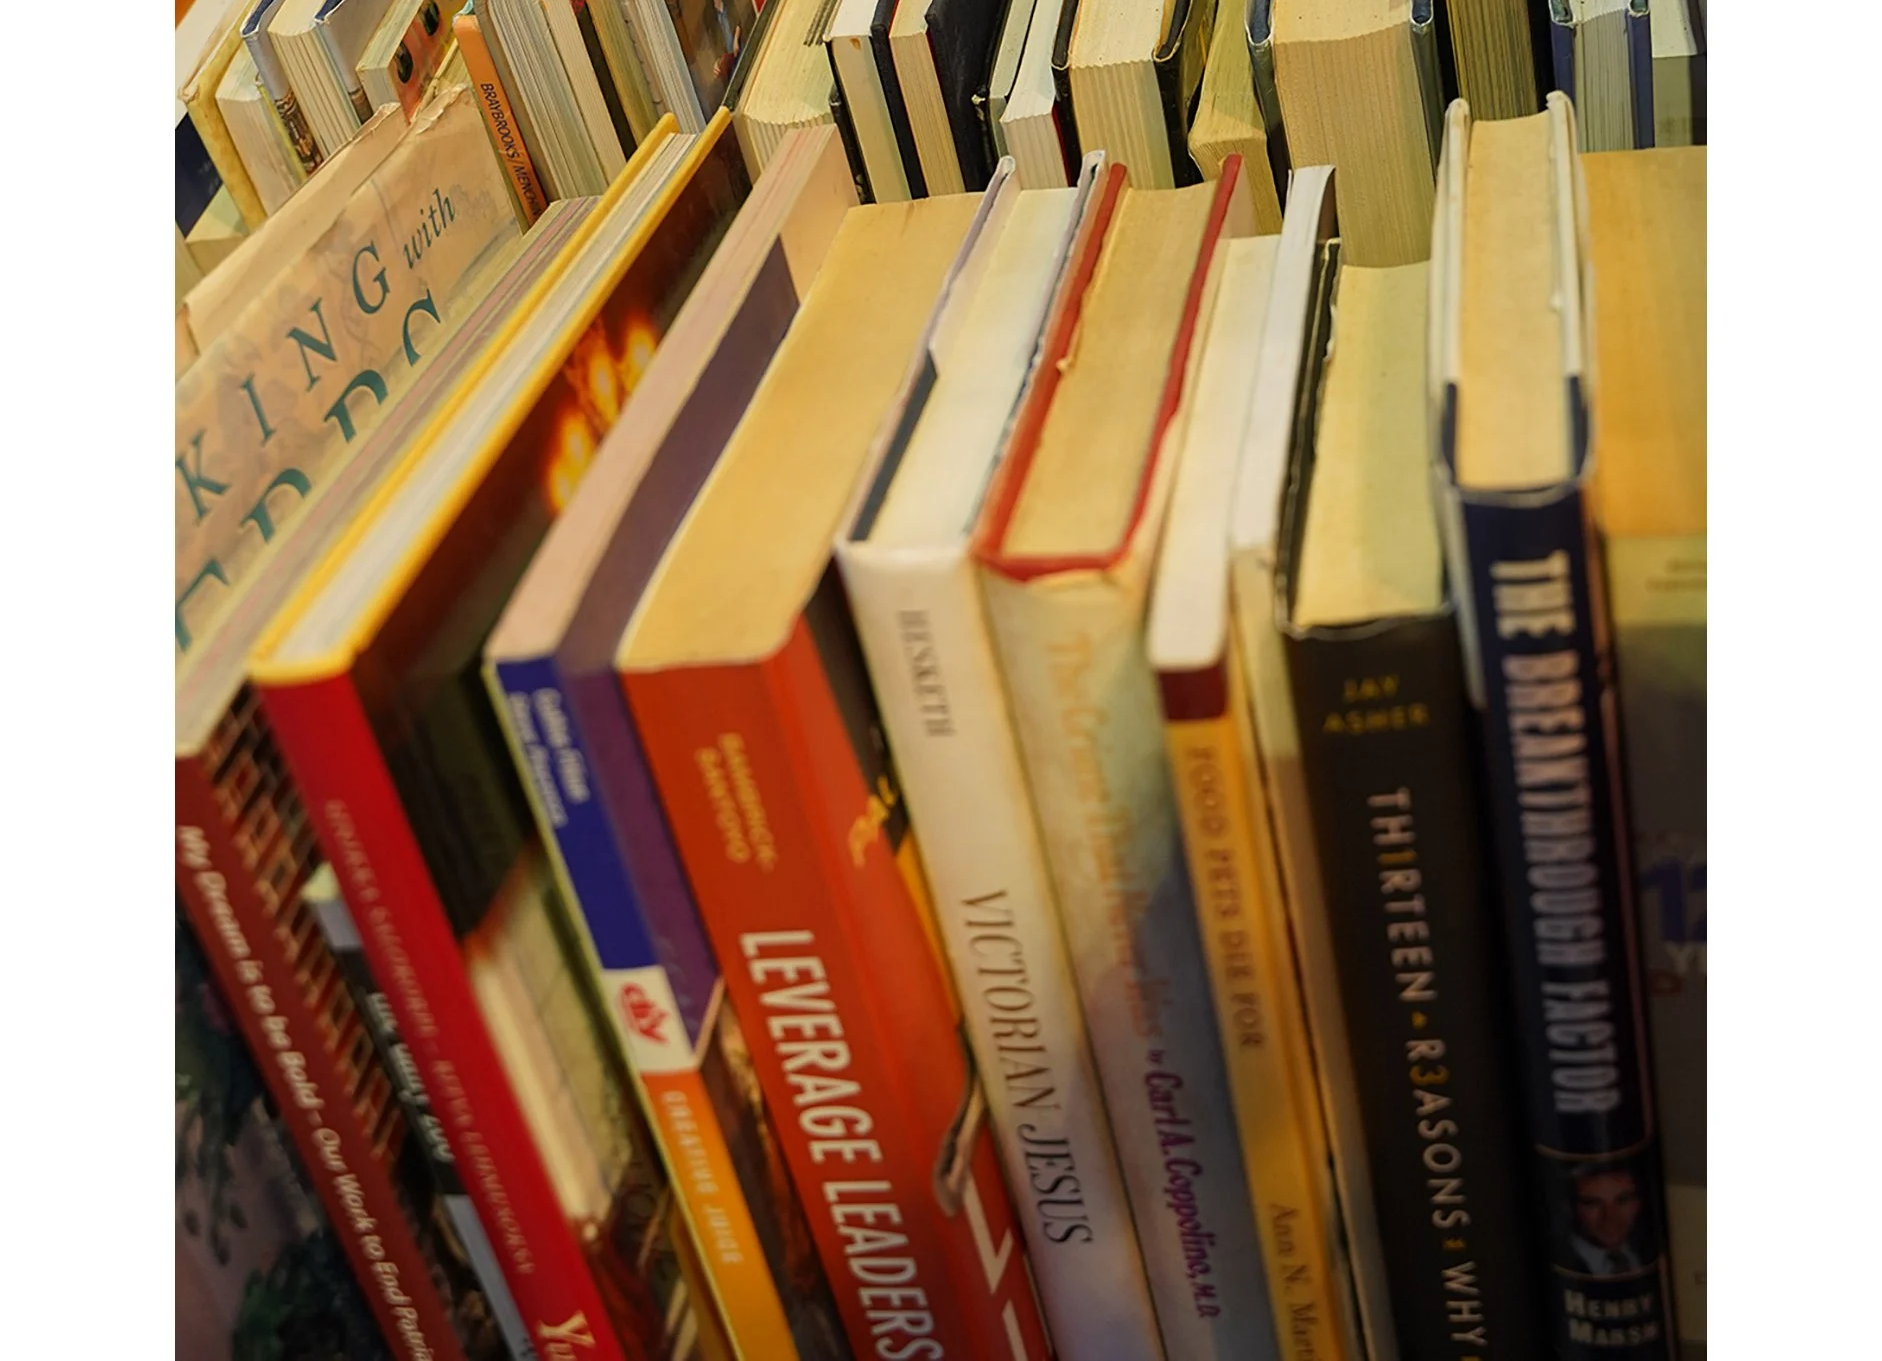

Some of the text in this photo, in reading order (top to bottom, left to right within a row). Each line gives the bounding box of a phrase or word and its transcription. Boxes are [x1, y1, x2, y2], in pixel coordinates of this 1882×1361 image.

[176, 239, 391, 527] KING
[404, 188, 457, 270] with
[896, 608, 956, 738] HESKETH
[1343, 674, 1400, 704] JAY
[1323, 703, 1430, 735] ASHER
[178, 825, 212, 869] My
[1490, 549, 1621, 1115] THE BREAKTHROUGH FACTOR
[193, 870, 251, 959] Dream
[1186, 746, 1267, 1050] FOOD PETS DIE FOR
[247, 985, 276, 1014] to
[261, 1015, 292, 1050] be
[276, 1051, 326, 1110] Bold
[961, 890, 1062, 1112] VICTORIAN
[1020, 1122, 1094, 1246] JESUS
[1145, 1071, 1193, 1127] Carl
[312, 1127, 349, 1173] Our
[740, 929, 943, 1361] LEVERAGE LEADERS
[332, 1173, 378, 1233] Work
[1404, 1040, 1472, 1229] R3ASONS
[1441, 1260, 1487, 1346] WHY
[360, 1234, 386, 1260] to
[1270, 1203, 1298, 1258] Ann
[371, 1261, 413, 1305] End
